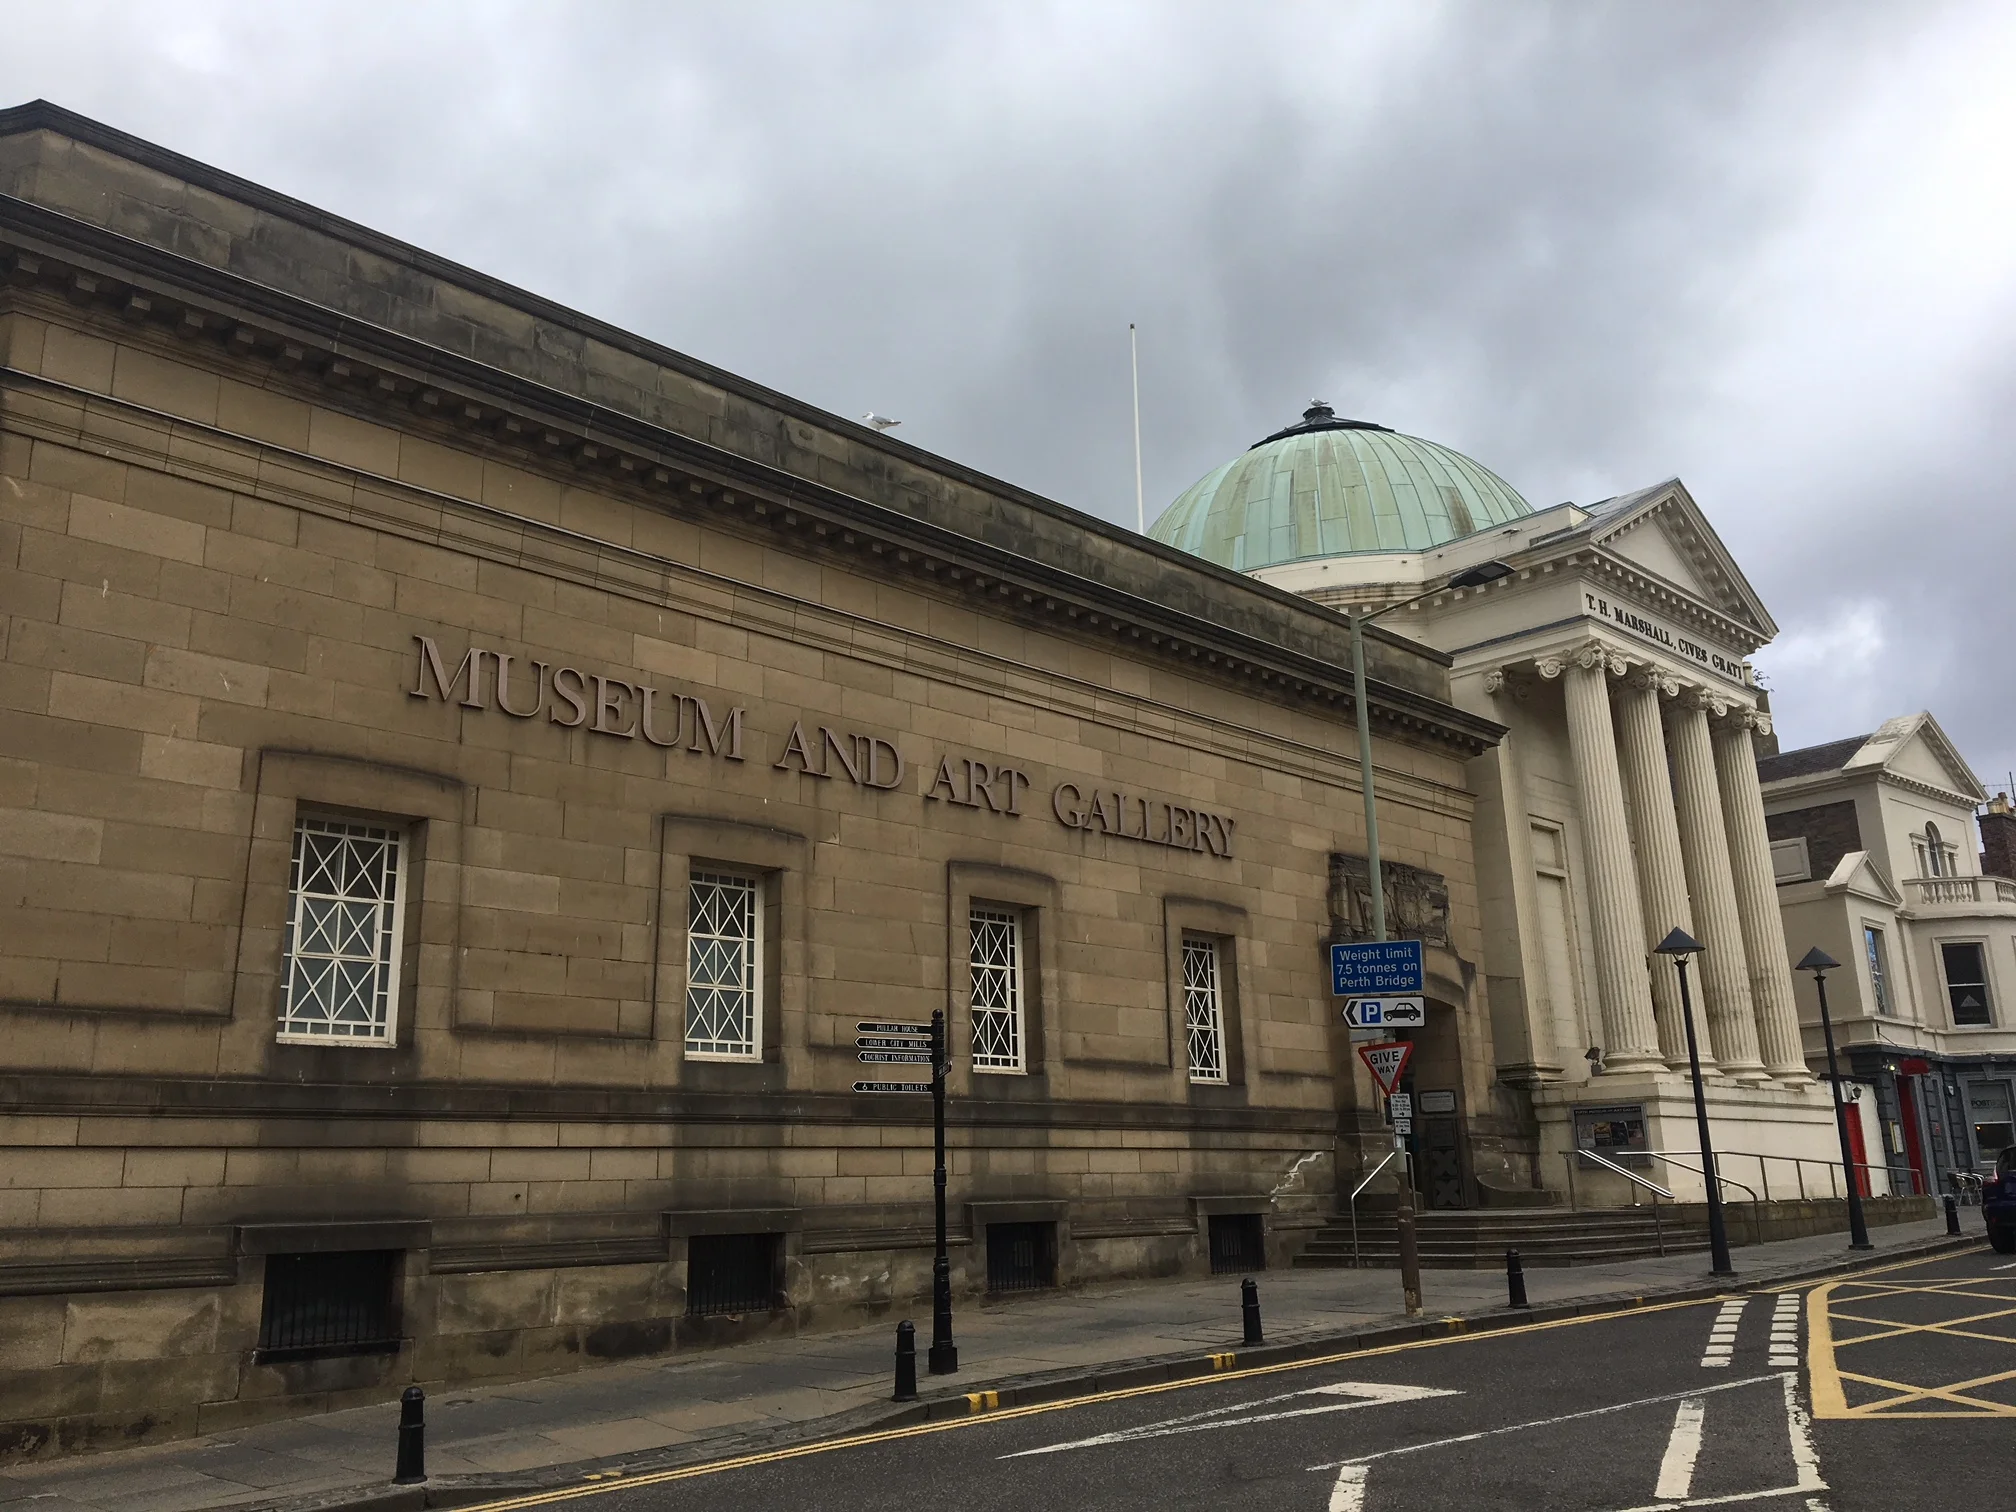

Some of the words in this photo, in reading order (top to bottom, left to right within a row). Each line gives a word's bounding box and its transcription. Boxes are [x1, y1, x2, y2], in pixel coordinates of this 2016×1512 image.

[1679, 638, 1708, 663] CIVES
[1711, 654, 1743, 680] GRATI
[410, 634, 747, 762] MUSEUM
[774, 720, 905, 790] AND
[926, 754, 1030, 817] ART
[1053, 782, 1237, 859] GALLERY
[1340, 949, 1380, 962] Weight
[1385, 947, 1413, 959] limit
[1336, 964, 1353, 975] 7.5
[1357, 963, 1397, 974] tonnes
[1402, 962, 1417, 971] on
[1340, 976, 1371, 988] Perth
[1376, 975, 1415, 988] Bridge
[1365, 1004, 1378, 1022] P
[876, 1024, 899, 1032] PULLAR
[865, 1039, 887, 1047] LOWER
[908, 1040, 927, 1048] MILLS
[864, 1053, 888, 1061] TOURIST
[891, 1054, 930, 1062] INFORMATION
[1370, 1050, 1400, 1065] GIVE
[1377, 1065, 1396, 1074] WAY
[873, 1083, 897, 1091] PUBLIC
